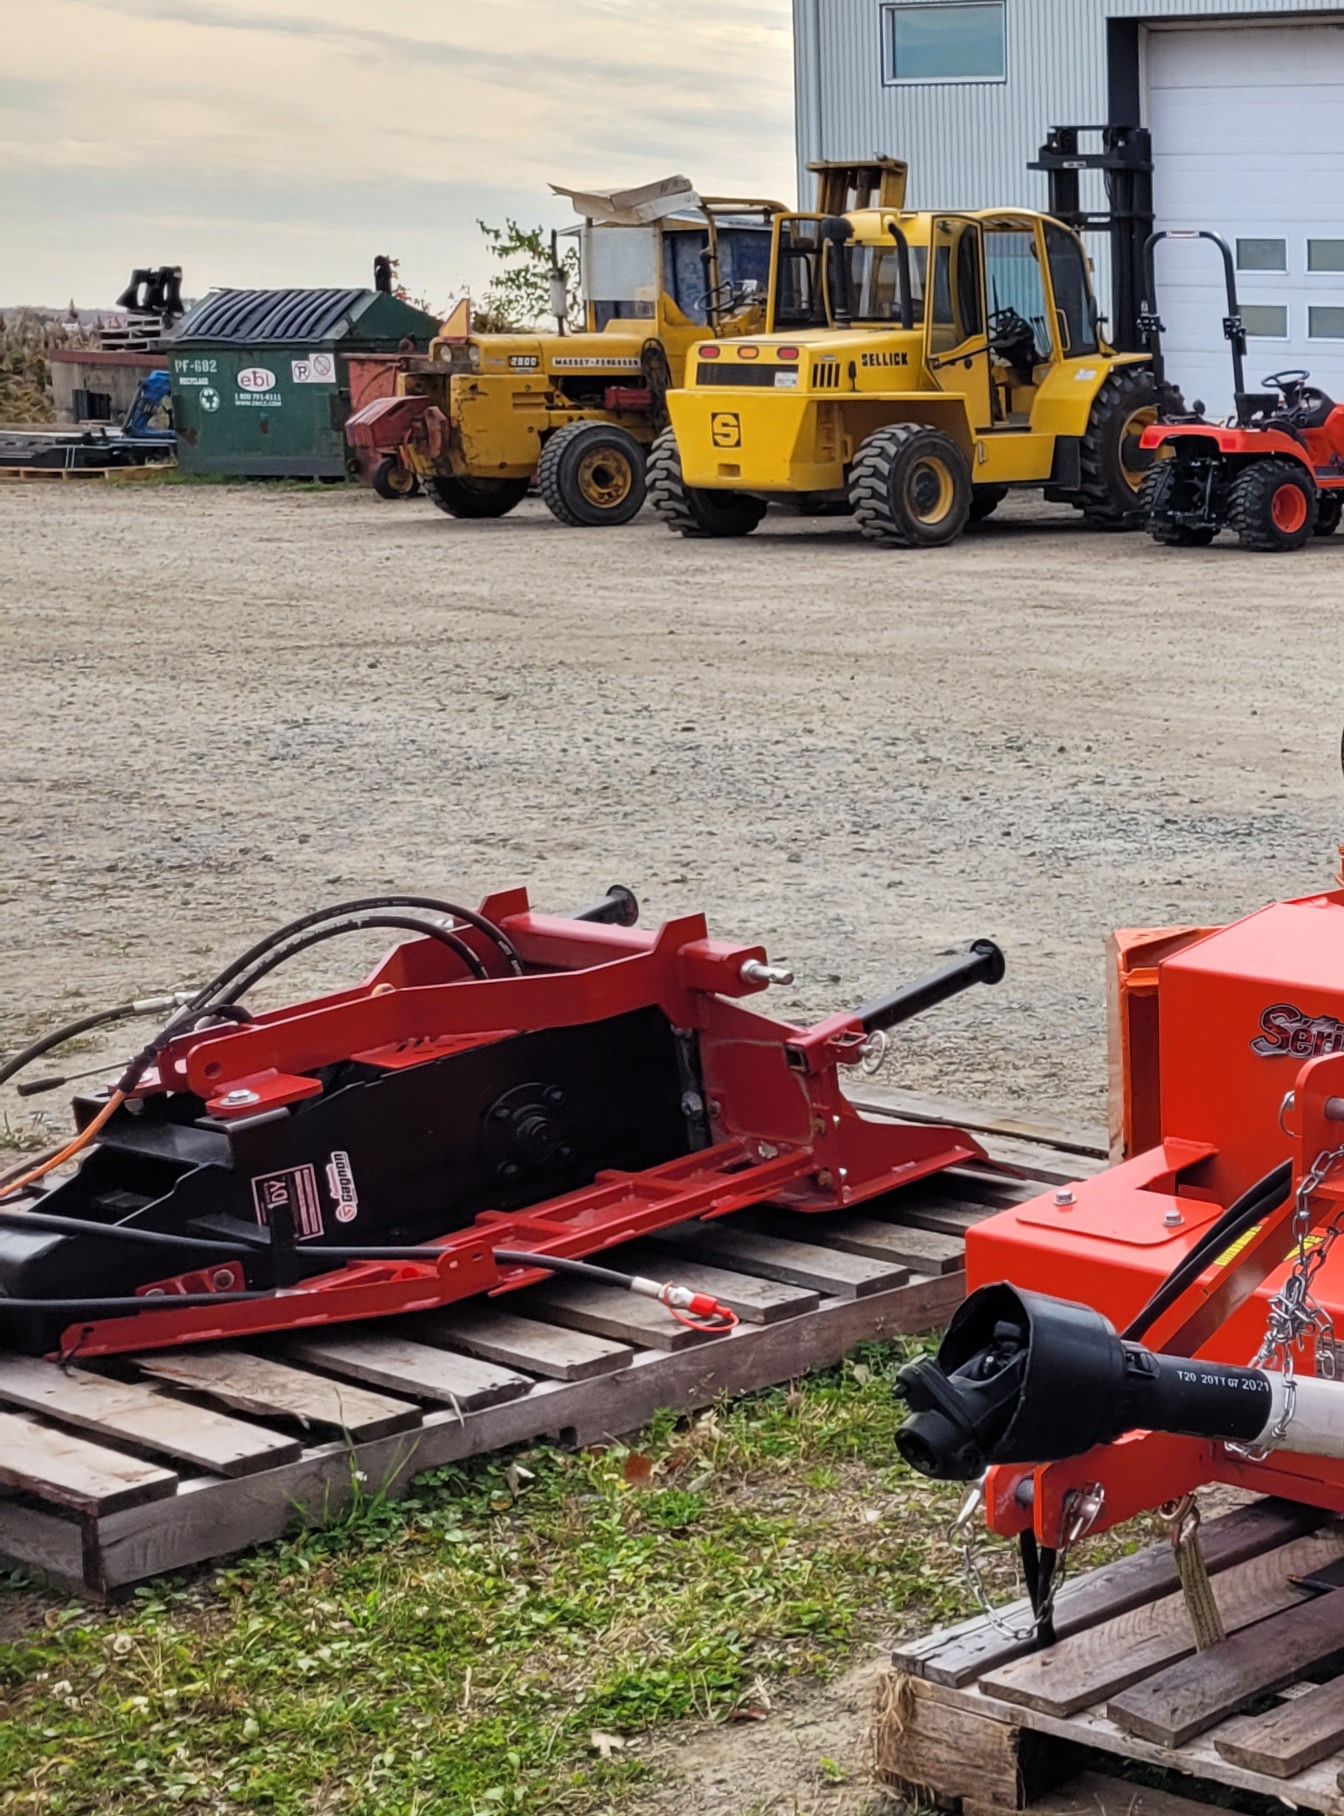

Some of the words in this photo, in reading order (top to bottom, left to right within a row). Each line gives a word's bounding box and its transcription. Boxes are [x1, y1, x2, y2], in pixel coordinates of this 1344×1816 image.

[174, 359, 218, 373] PF-602
[861, 352, 909, 367] SELLICK
[1177, 1370, 1197, 1383] T20
